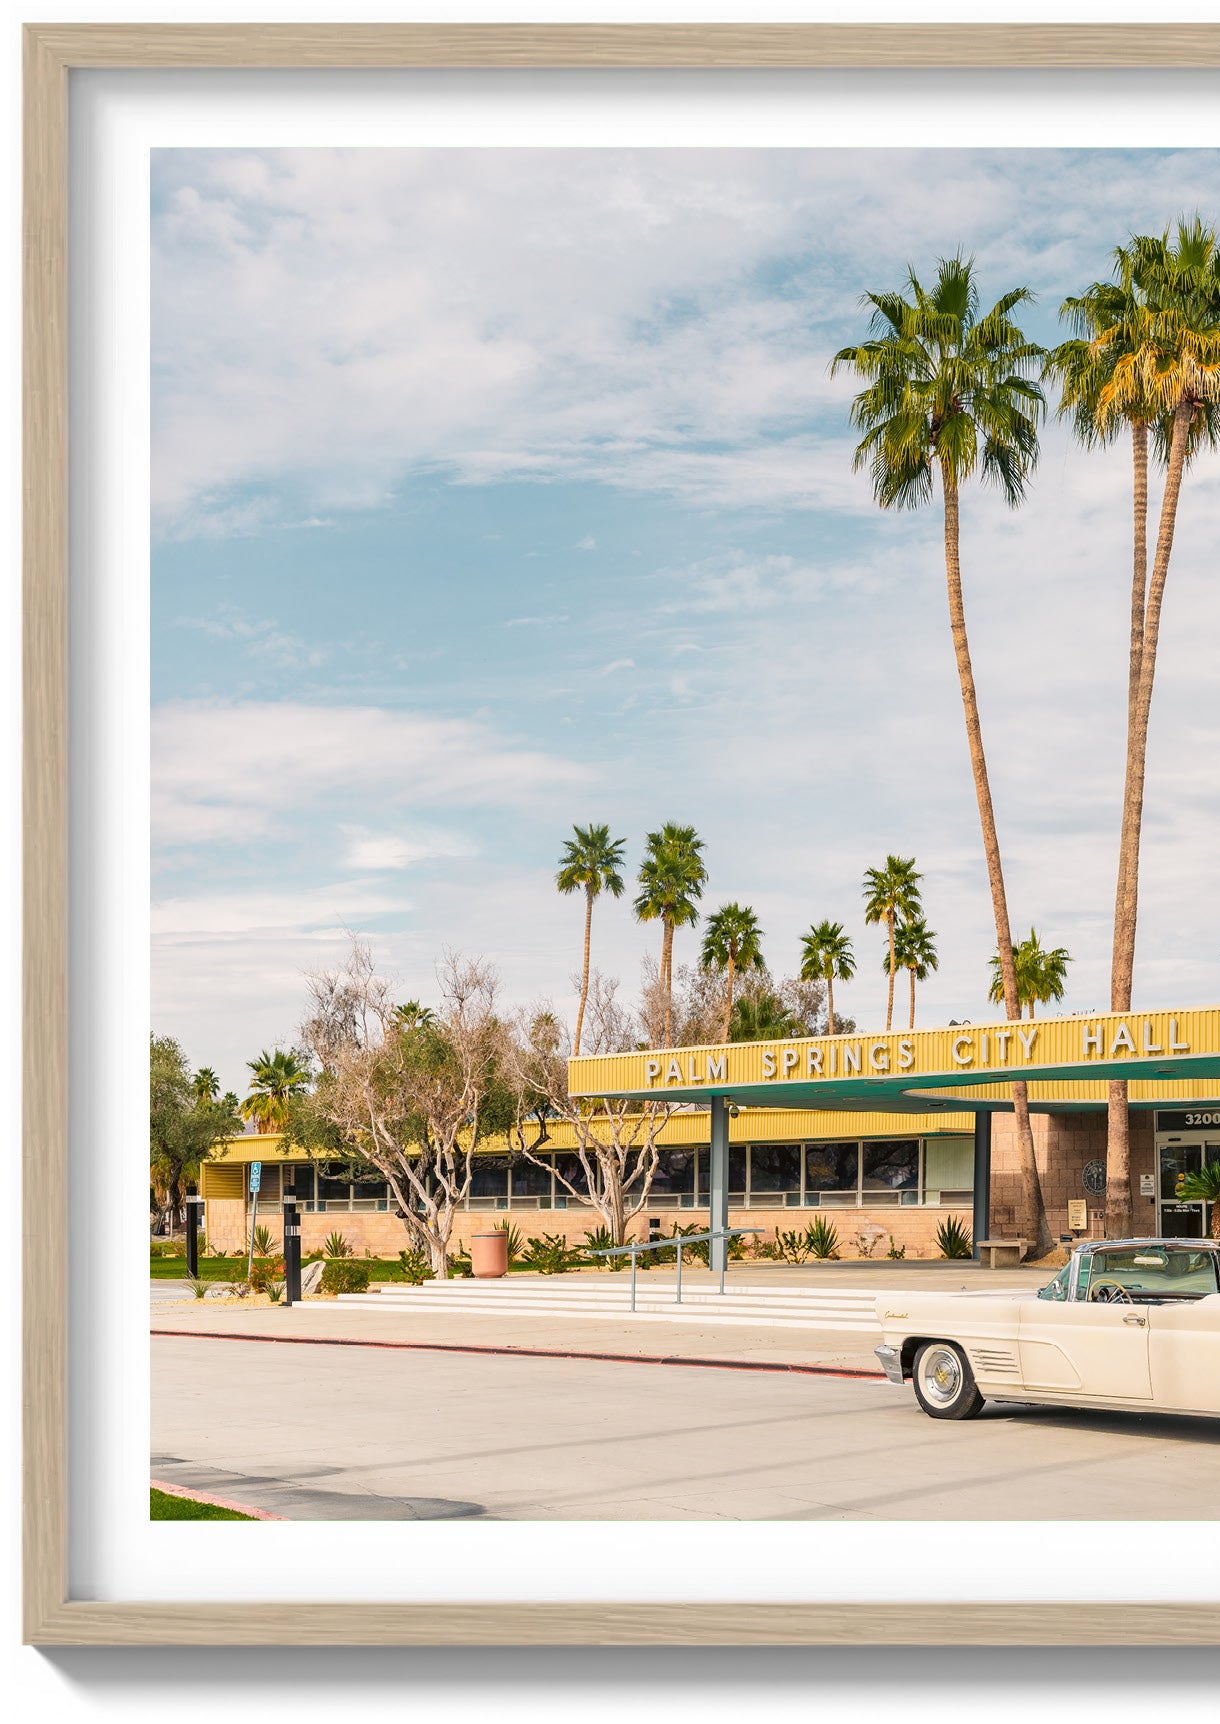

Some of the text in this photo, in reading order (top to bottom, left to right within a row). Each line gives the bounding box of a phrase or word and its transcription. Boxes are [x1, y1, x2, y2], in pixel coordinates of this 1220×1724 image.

[645, 1018, 1190, 1085] PALM SPRINGS CITY HALL
